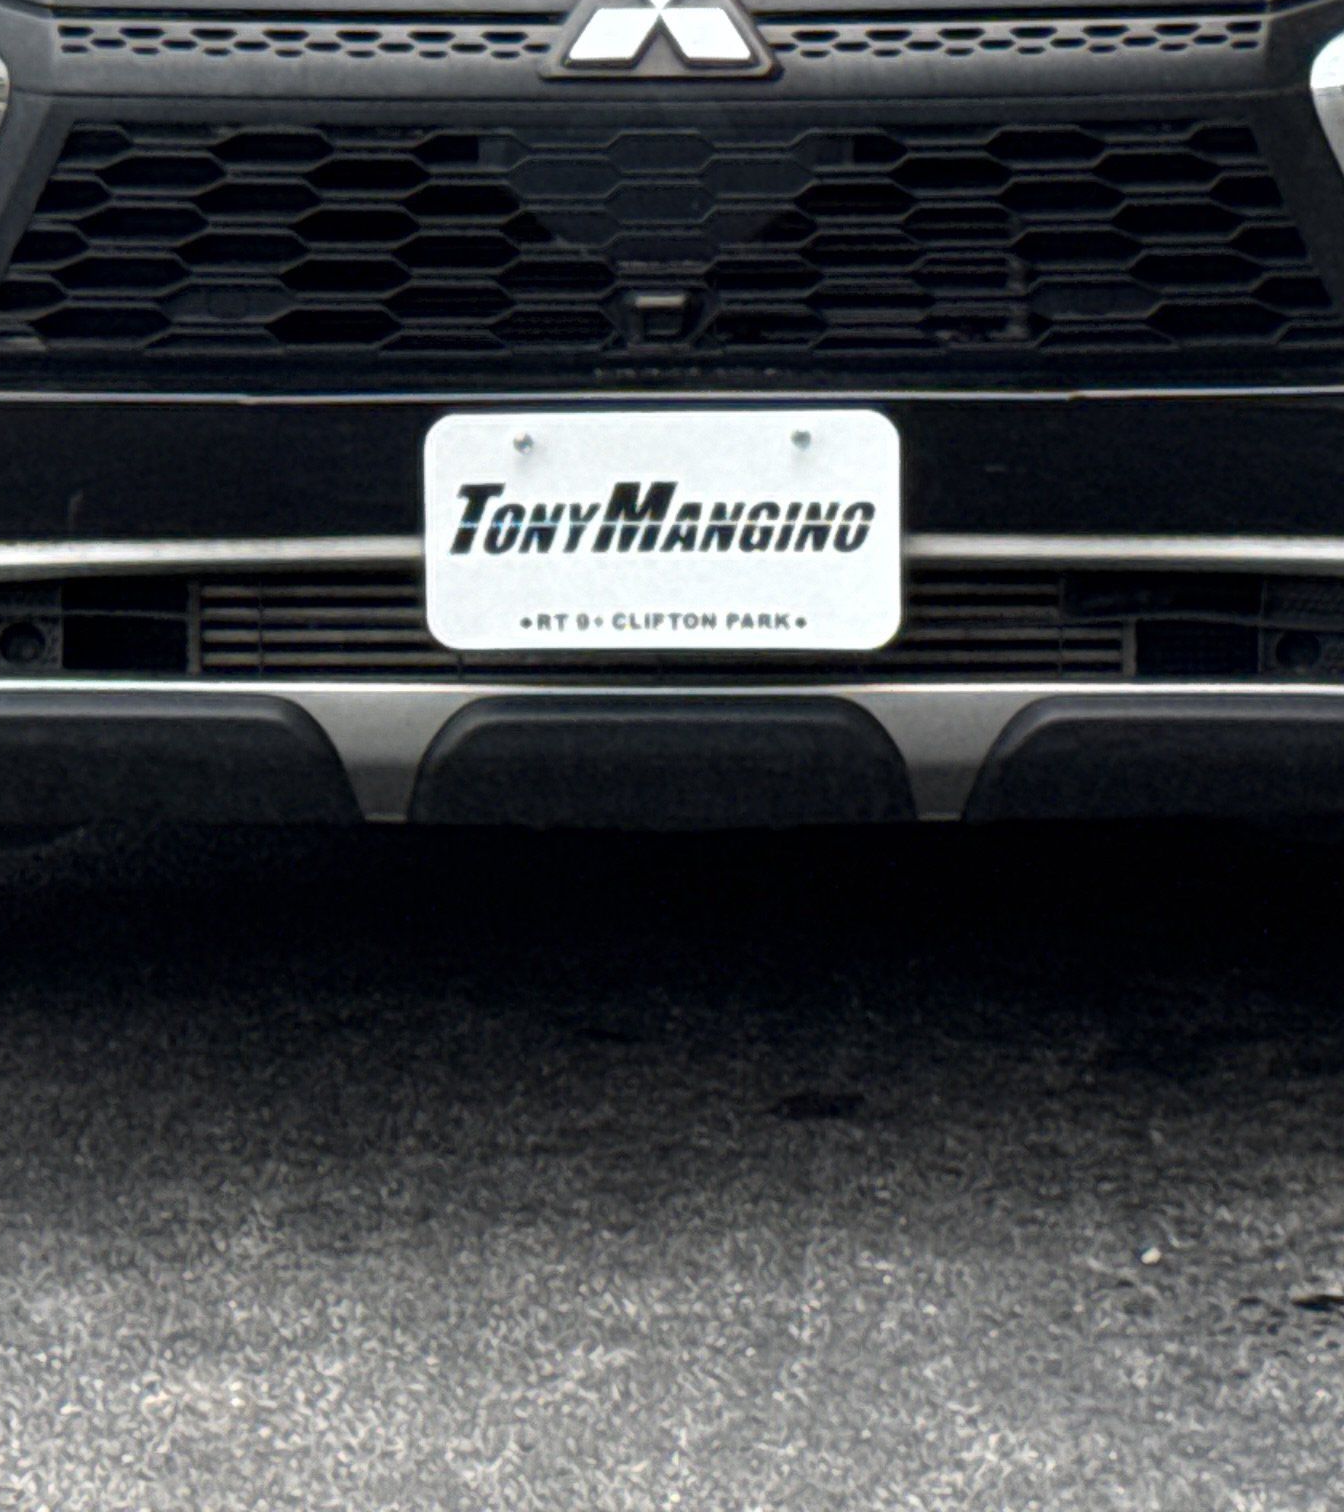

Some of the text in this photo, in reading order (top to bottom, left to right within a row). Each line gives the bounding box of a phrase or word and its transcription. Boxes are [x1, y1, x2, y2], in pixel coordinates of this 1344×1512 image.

[536, 613, 569, 631] RT
[611, 611, 718, 631] CLIFTON
[726, 611, 791, 631] PARK
